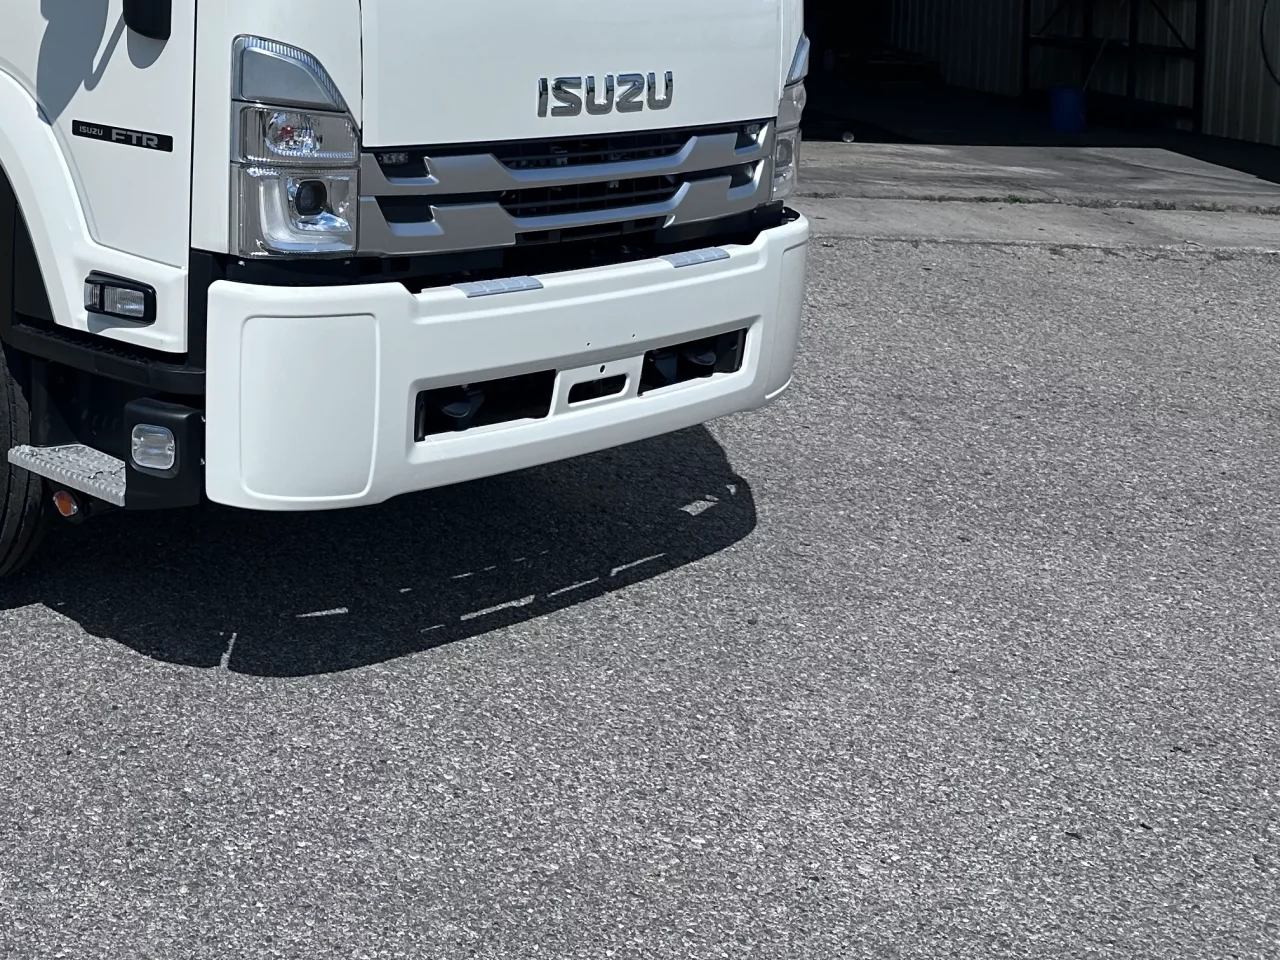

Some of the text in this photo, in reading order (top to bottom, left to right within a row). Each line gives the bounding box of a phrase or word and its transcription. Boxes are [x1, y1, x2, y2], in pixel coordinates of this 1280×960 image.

[537, 70, 674, 118] ISUZU
[79, 125, 159, 148] ISUZU FTR
